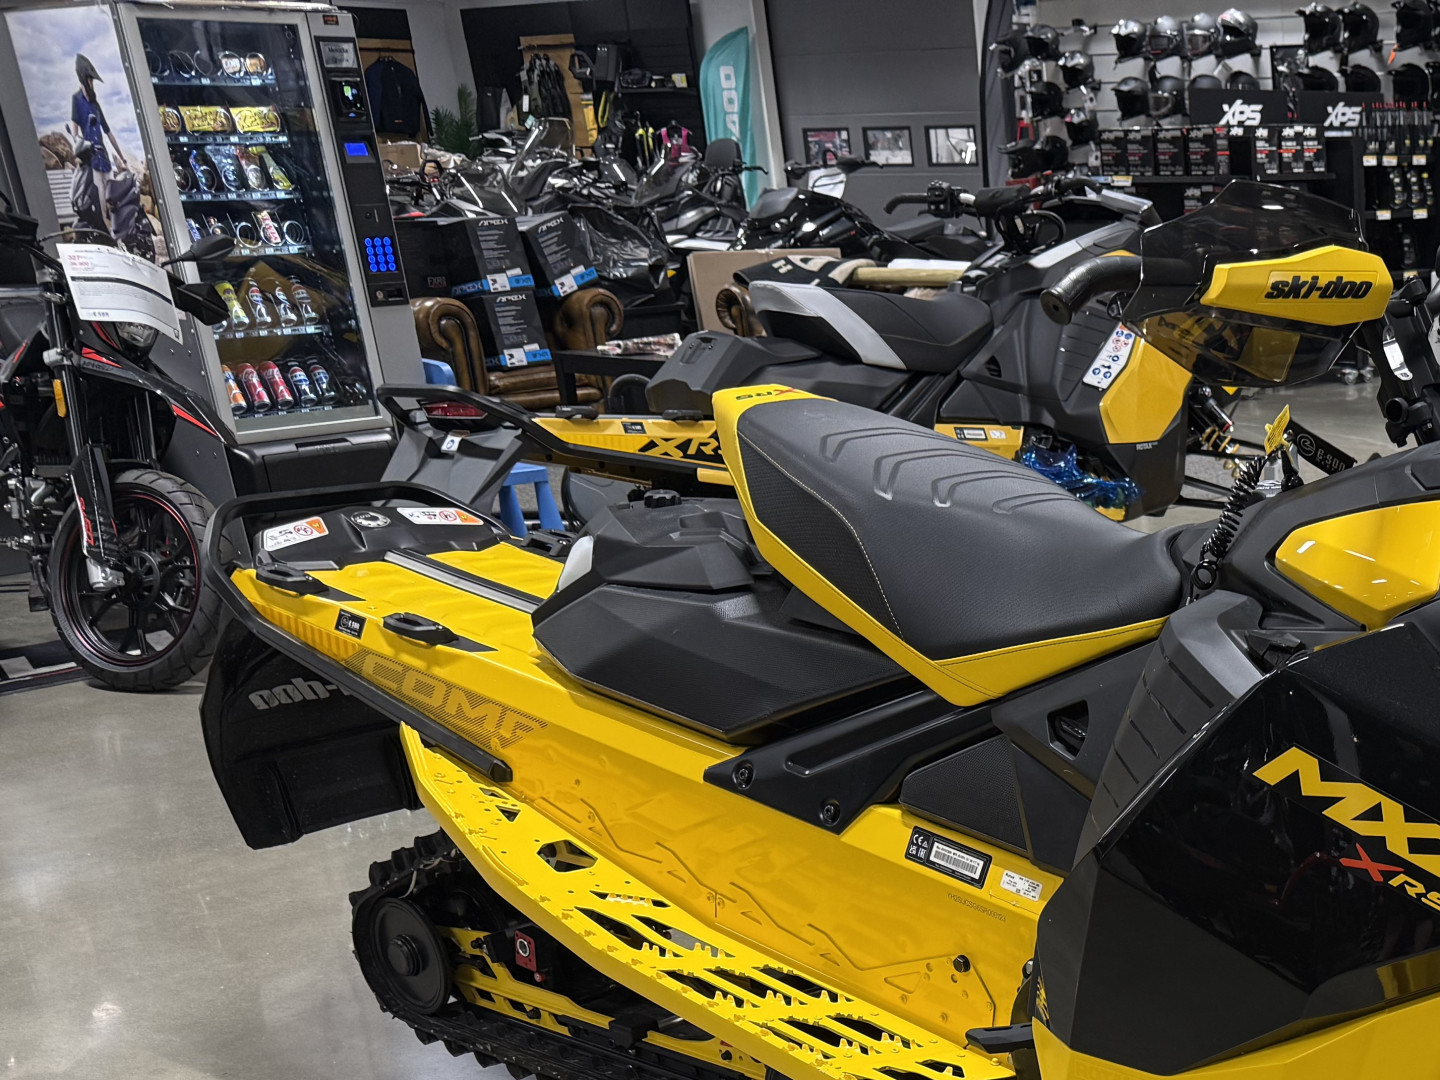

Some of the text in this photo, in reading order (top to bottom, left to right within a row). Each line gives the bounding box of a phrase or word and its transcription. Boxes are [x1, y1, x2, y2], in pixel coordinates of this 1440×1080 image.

[1220, 99, 1263, 126] XPS
[1324, 102, 1362, 127] XPS
[1264, 275, 1373, 299] ski-doo
[643, 437, 722, 459] XR
